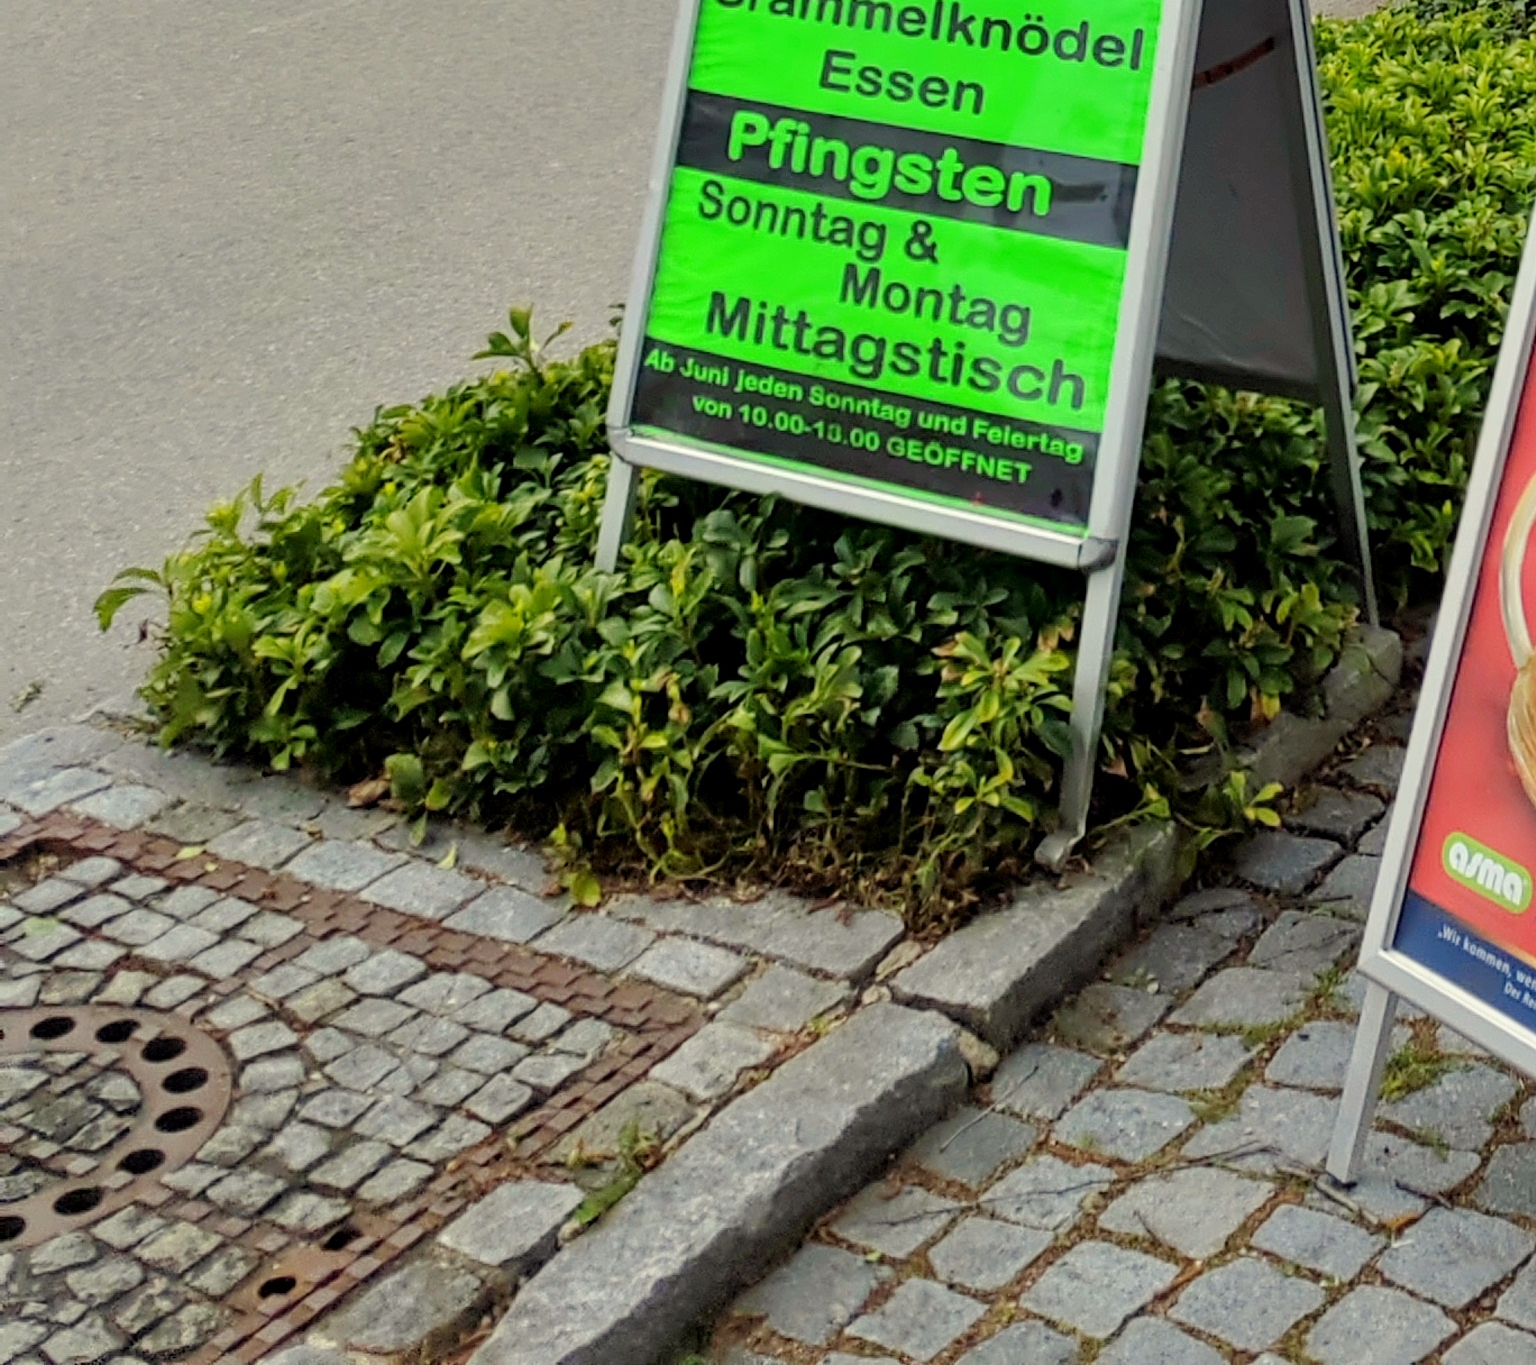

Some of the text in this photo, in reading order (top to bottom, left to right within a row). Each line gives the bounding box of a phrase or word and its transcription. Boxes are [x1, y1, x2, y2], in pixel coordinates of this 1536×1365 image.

[819, 50, 984, 115] Essen
[727, 110, 1052, 217] Pfingsten
[699, 179, 938, 264] Sonntag &
[840, 263, 1030, 347] Montag
[705, 291, 1085, 410] Mittagstisch
[644, 348, 1084, 464] Ab Juni jeden Sonntag und Feiertag
[692, 395, 732, 419] von
[887, 435, 1032, 484] GEÖFFNET
[1449, 841, 1523, 906] asma
[1463, 936, 1512, 978] kommen,
